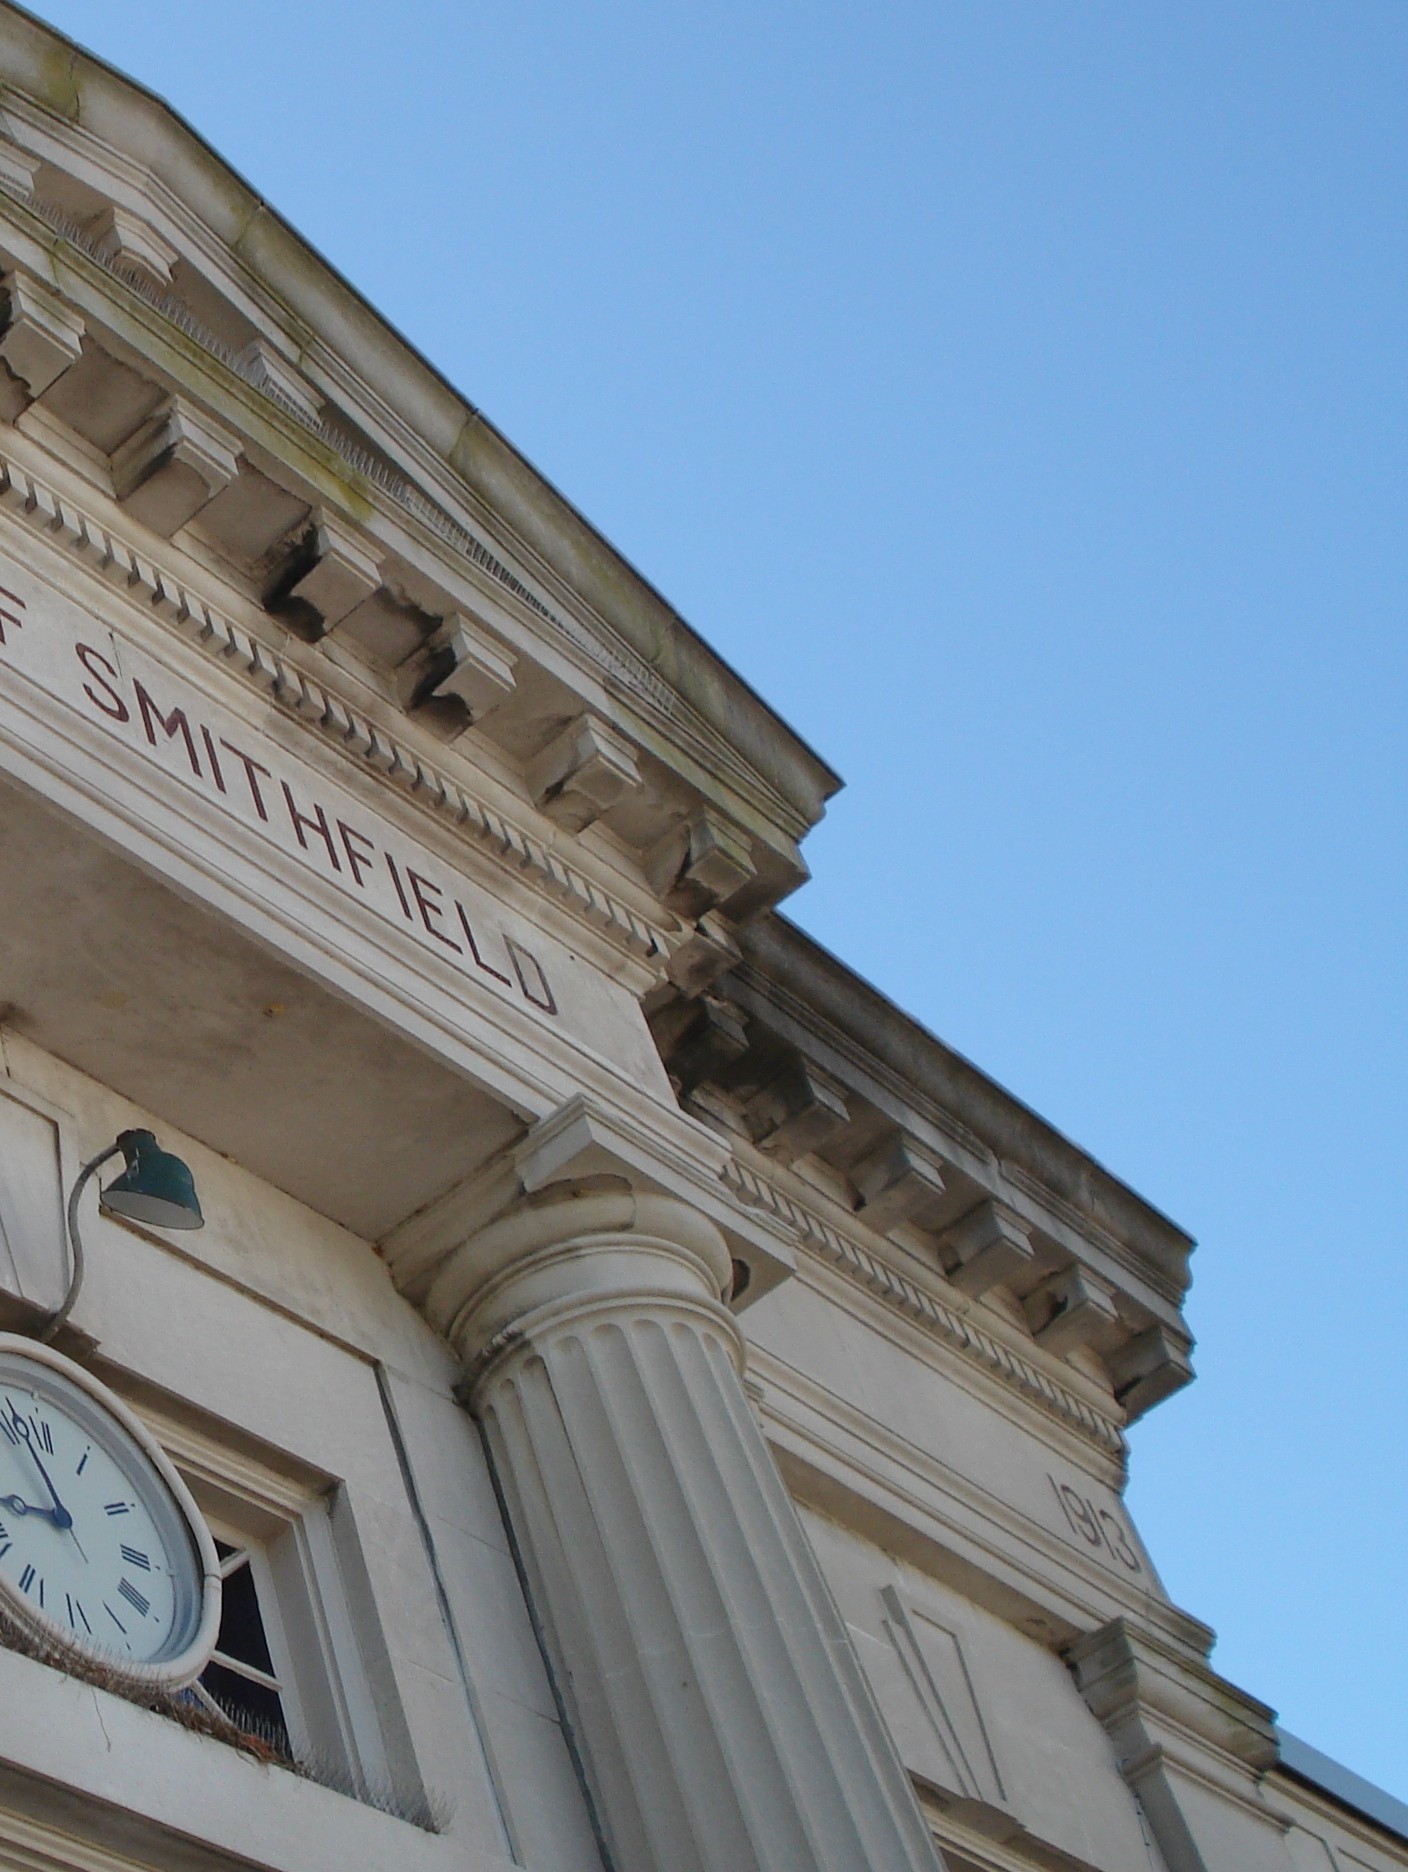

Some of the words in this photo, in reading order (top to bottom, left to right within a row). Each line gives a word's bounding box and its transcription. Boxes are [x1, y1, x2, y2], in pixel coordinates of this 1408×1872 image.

[74, 641, 558, 1016] SMITHFIELD
[103, 1501, 130, 1516] II
[1045, 1471, 1141, 1574] 1913
[119, 1543, 151, 1572] III
